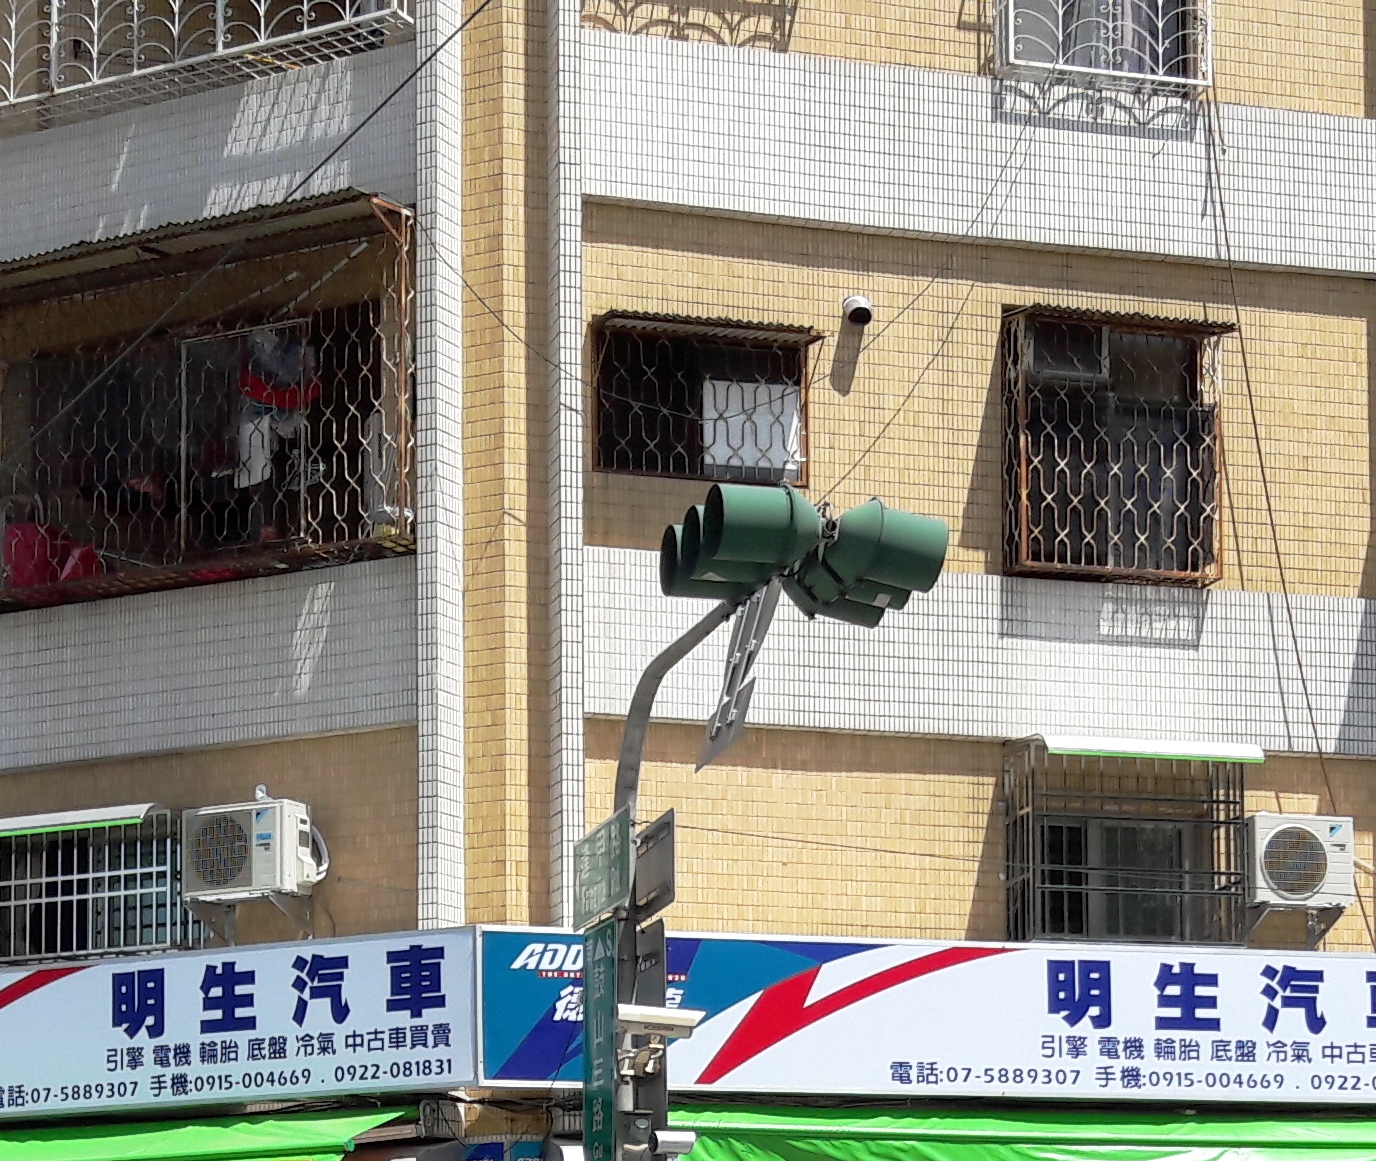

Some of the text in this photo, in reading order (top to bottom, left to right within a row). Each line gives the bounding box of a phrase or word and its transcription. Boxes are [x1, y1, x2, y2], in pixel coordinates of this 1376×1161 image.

[112, 945, 446, 1040] 明生汽車
[106, 1023, 452, 1072] 引擎 電機 輪胎 底盤 冷氣 中古車買賣
[593, 962, 605, 1133] 鼓山三路
[1040, 1035, 1088, 1059] 引擎
[1097, 1036, 1145, 1061] 電機
[1153, 1037, 1201, 1062] 輪胎
[1210, 1039, 1257, 1063] 底盤
[1266, 1040, 1312, 1064] 冷氣
[149, 1068, 312, 1097] 手機:0915-004669
[334, 1058, 452, 1082] 0922-081831
[889, 1061, 1081, 1086] 電話:07-5889307
[1095, 1065, 1284, 1089] 手機:0915-004669
